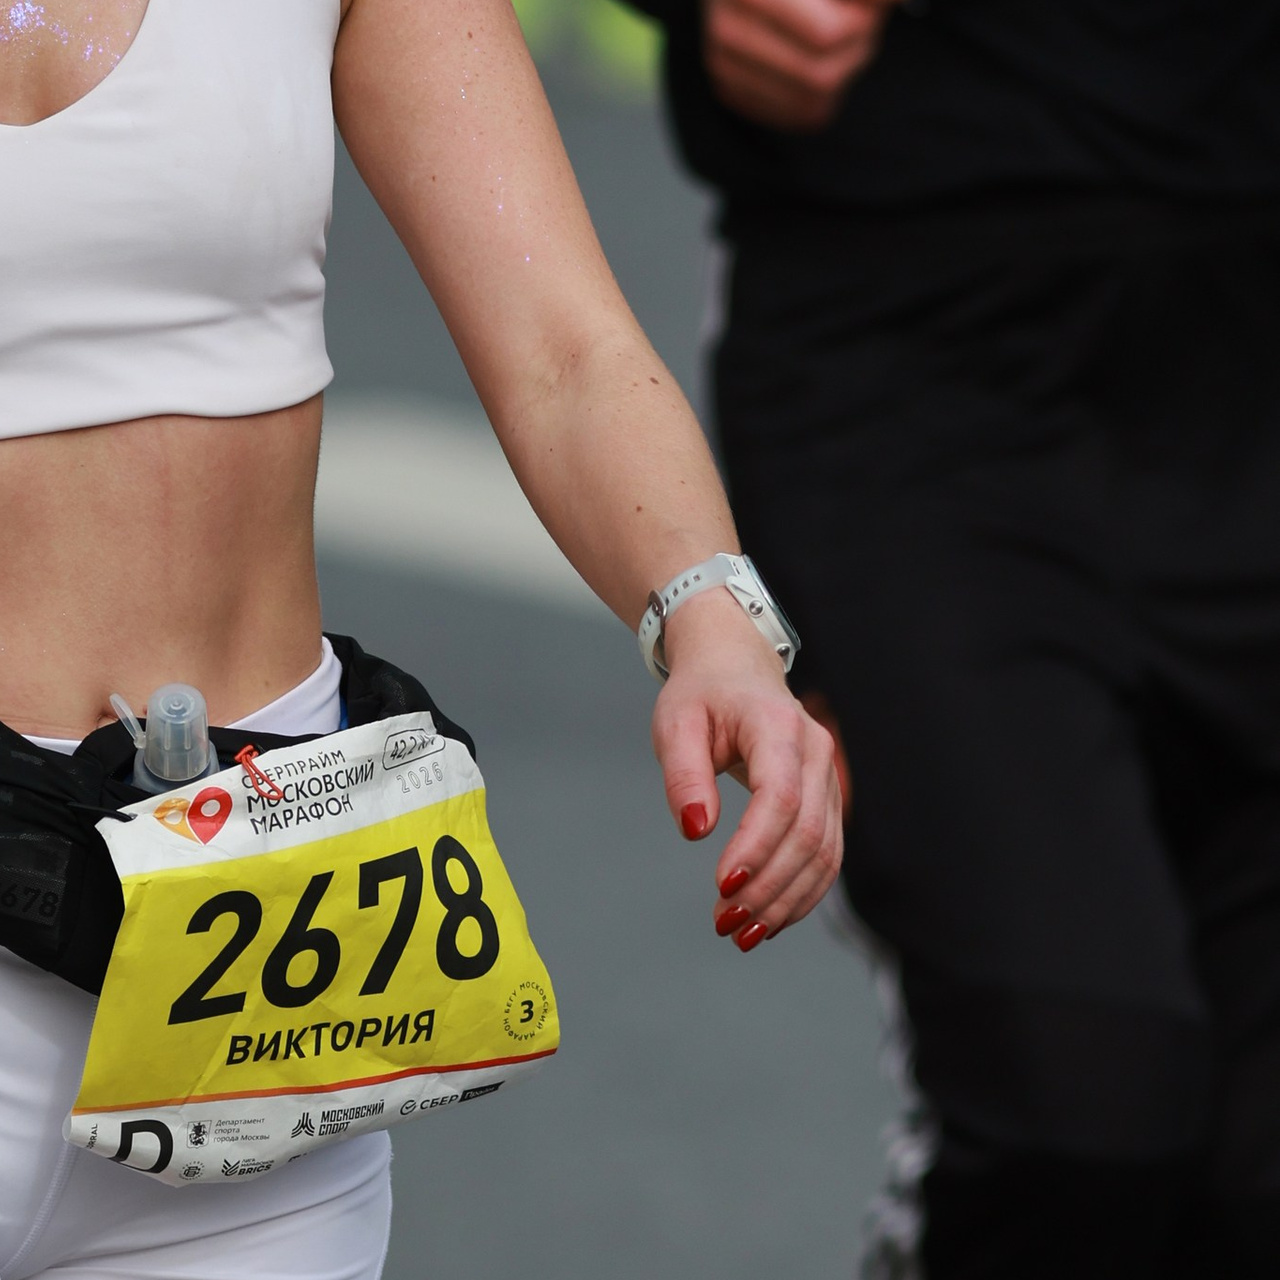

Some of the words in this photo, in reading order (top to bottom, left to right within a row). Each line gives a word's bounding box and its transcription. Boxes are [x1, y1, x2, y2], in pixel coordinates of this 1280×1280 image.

[246, 759, 375, 814] МОСКОВСКИЙ
[396, 761, 444, 794] 2026
[250, 793, 354, 835] МАРАФОН
[167, 835, 500, 1026] 2678
[520, 999, 534, 1024] 3
[225, 1009, 436, 1067] ВИКТОРИЯ
[320, 1099, 384, 1124] МОСКОВСКИЙ
[420, 1094, 459, 1110] СБЕР
[215, 1117, 265, 1127] Департамент
[318, 1121, 351, 1137] СПОРТ
[107, 1119, 174, 1174] D
[213, 1135, 239, 1143] города
[238, 1164, 273, 1176] BRICS
